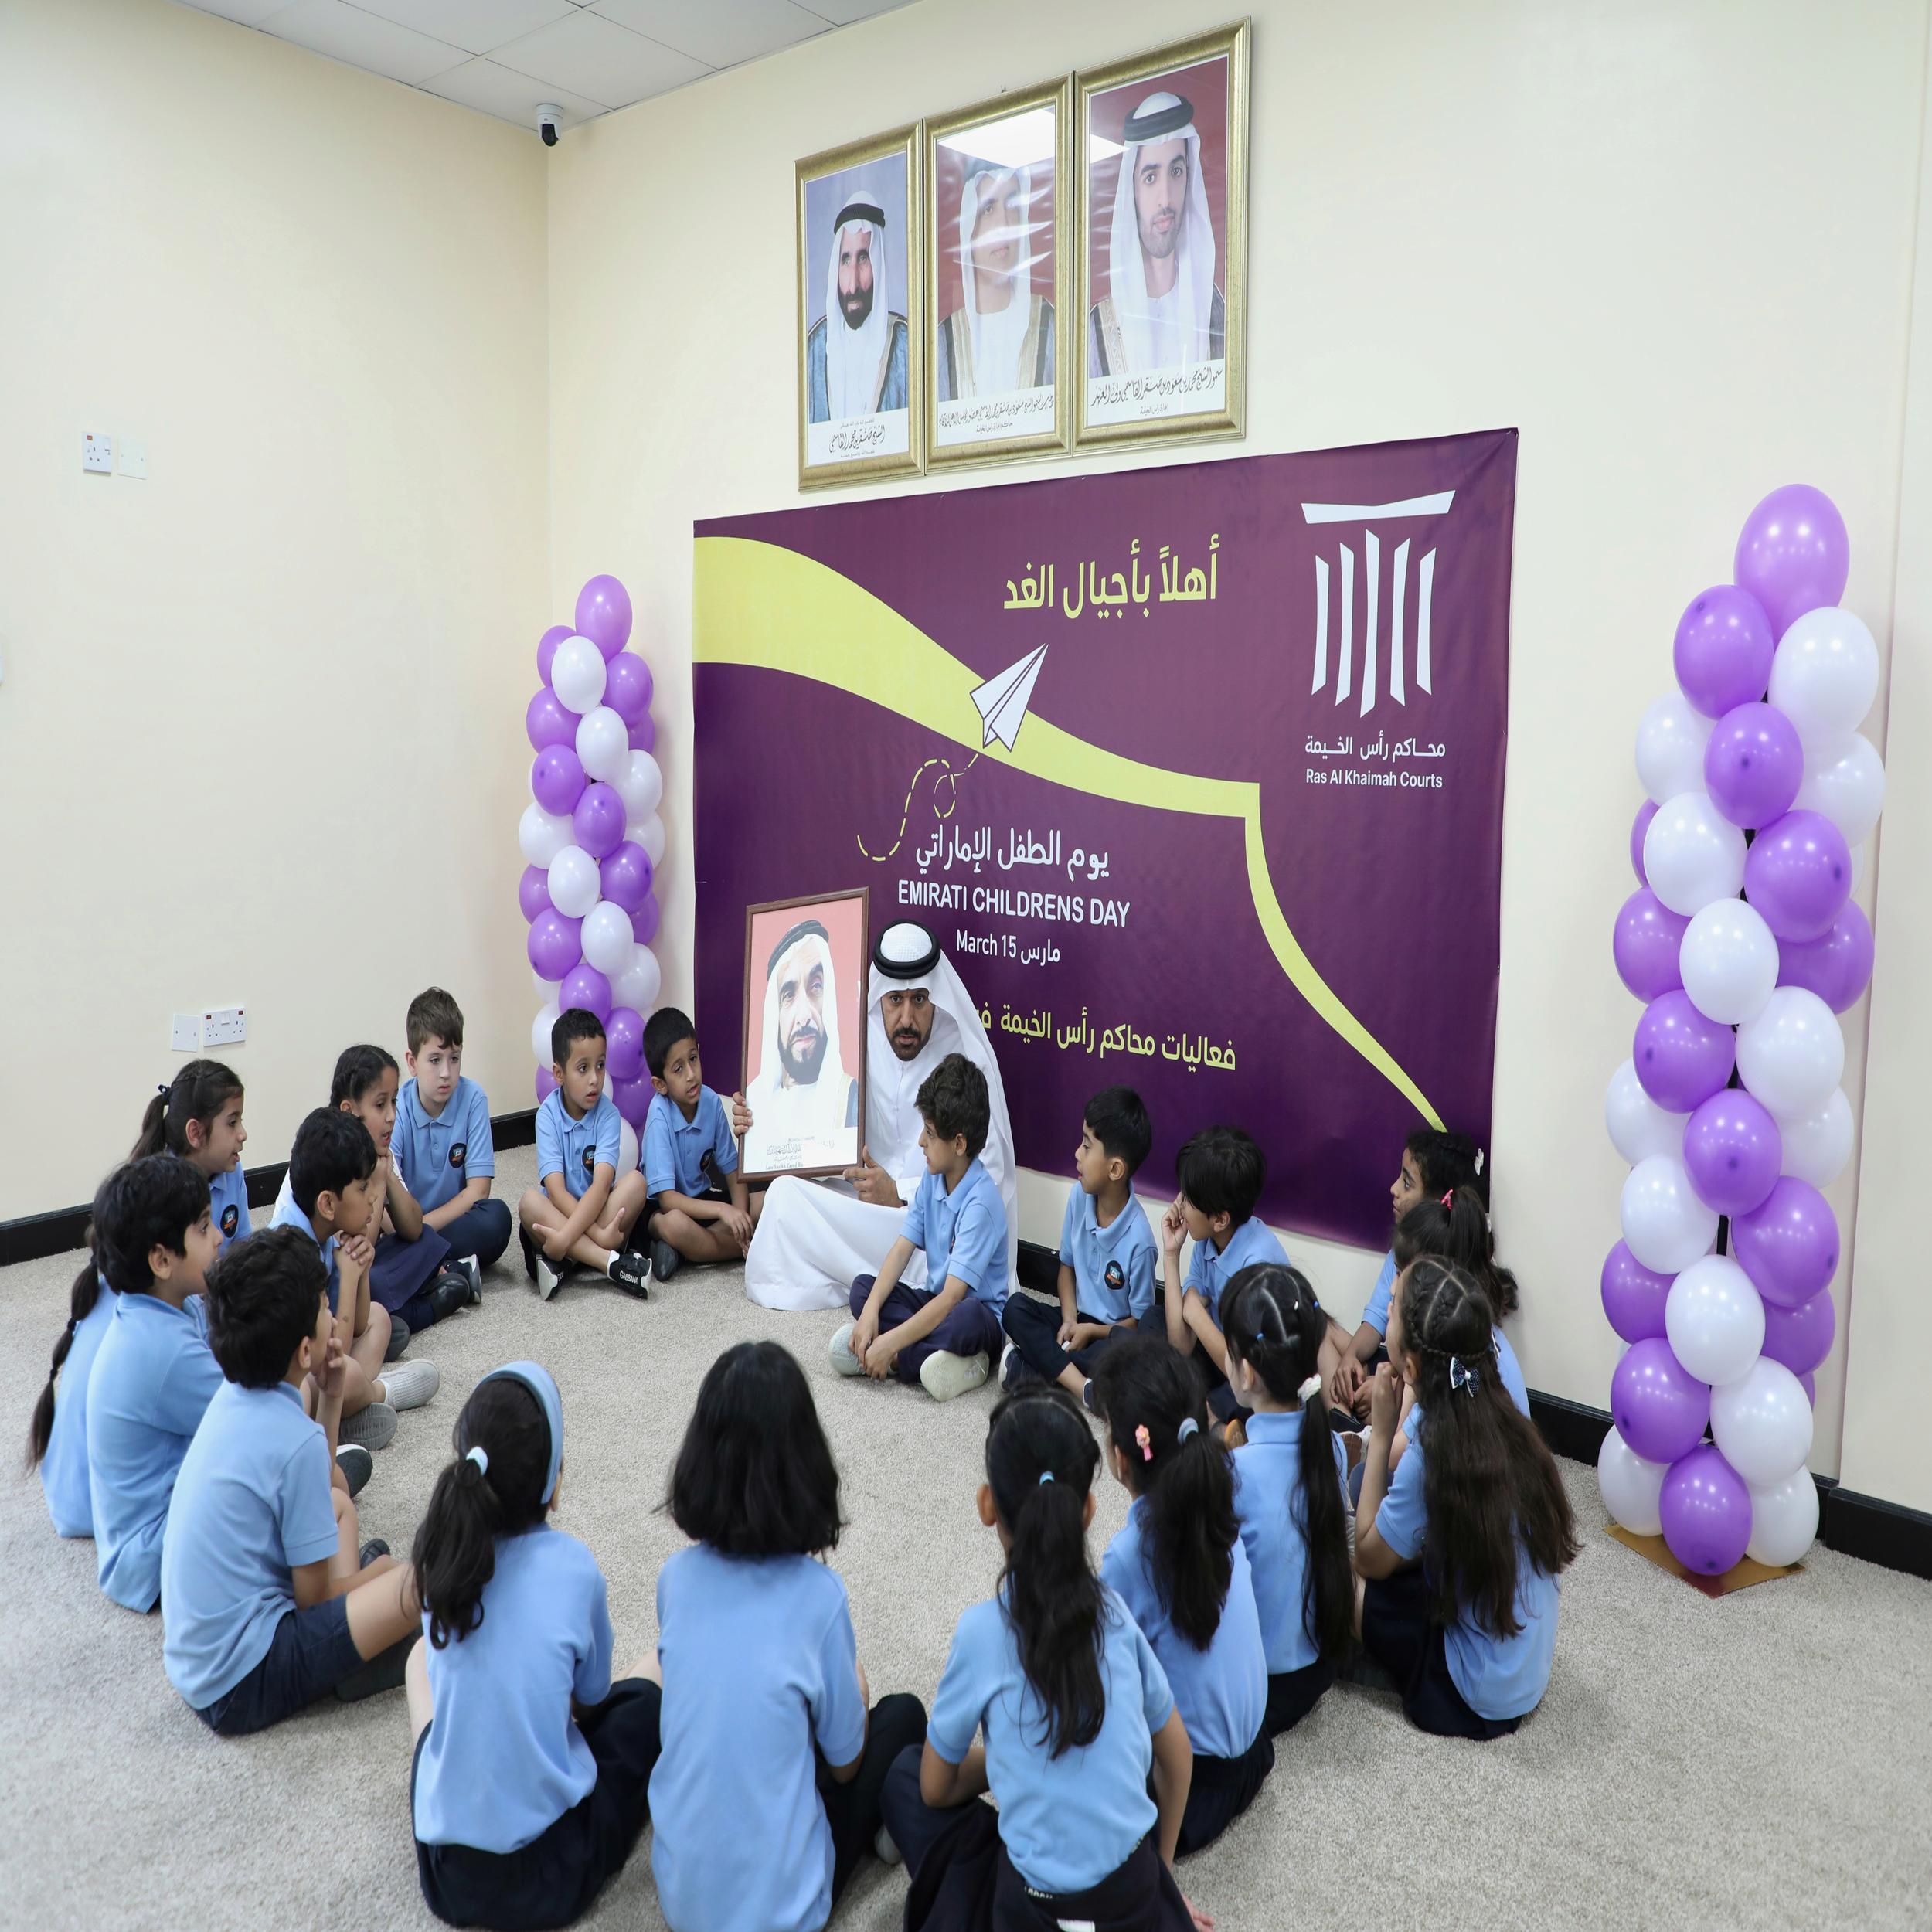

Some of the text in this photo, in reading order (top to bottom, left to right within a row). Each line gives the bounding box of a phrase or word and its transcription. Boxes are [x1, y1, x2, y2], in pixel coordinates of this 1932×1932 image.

[1004, 533, 1220, 619] أهلاً بأجيال الغد
[1304, 730, 1446, 763] محاكم رأس الخيمة
[1306, 768, 1443, 788] Ras Al Khaimah Courts
[916, 824, 1110, 882] يوم الطفل الإماراتي
[898, 879, 1131, 928] EMIRATI CHILDRENS DAY
[957, 929, 1061, 966] March 15 مارس
[1000, 1004, 1051, 1043] الخيمة
[1056, 1006, 1095, 1053] رأس
[1100, 1024, 1155, 1059] محاكم
[1162, 1033, 1236, 1073] فعاليات
